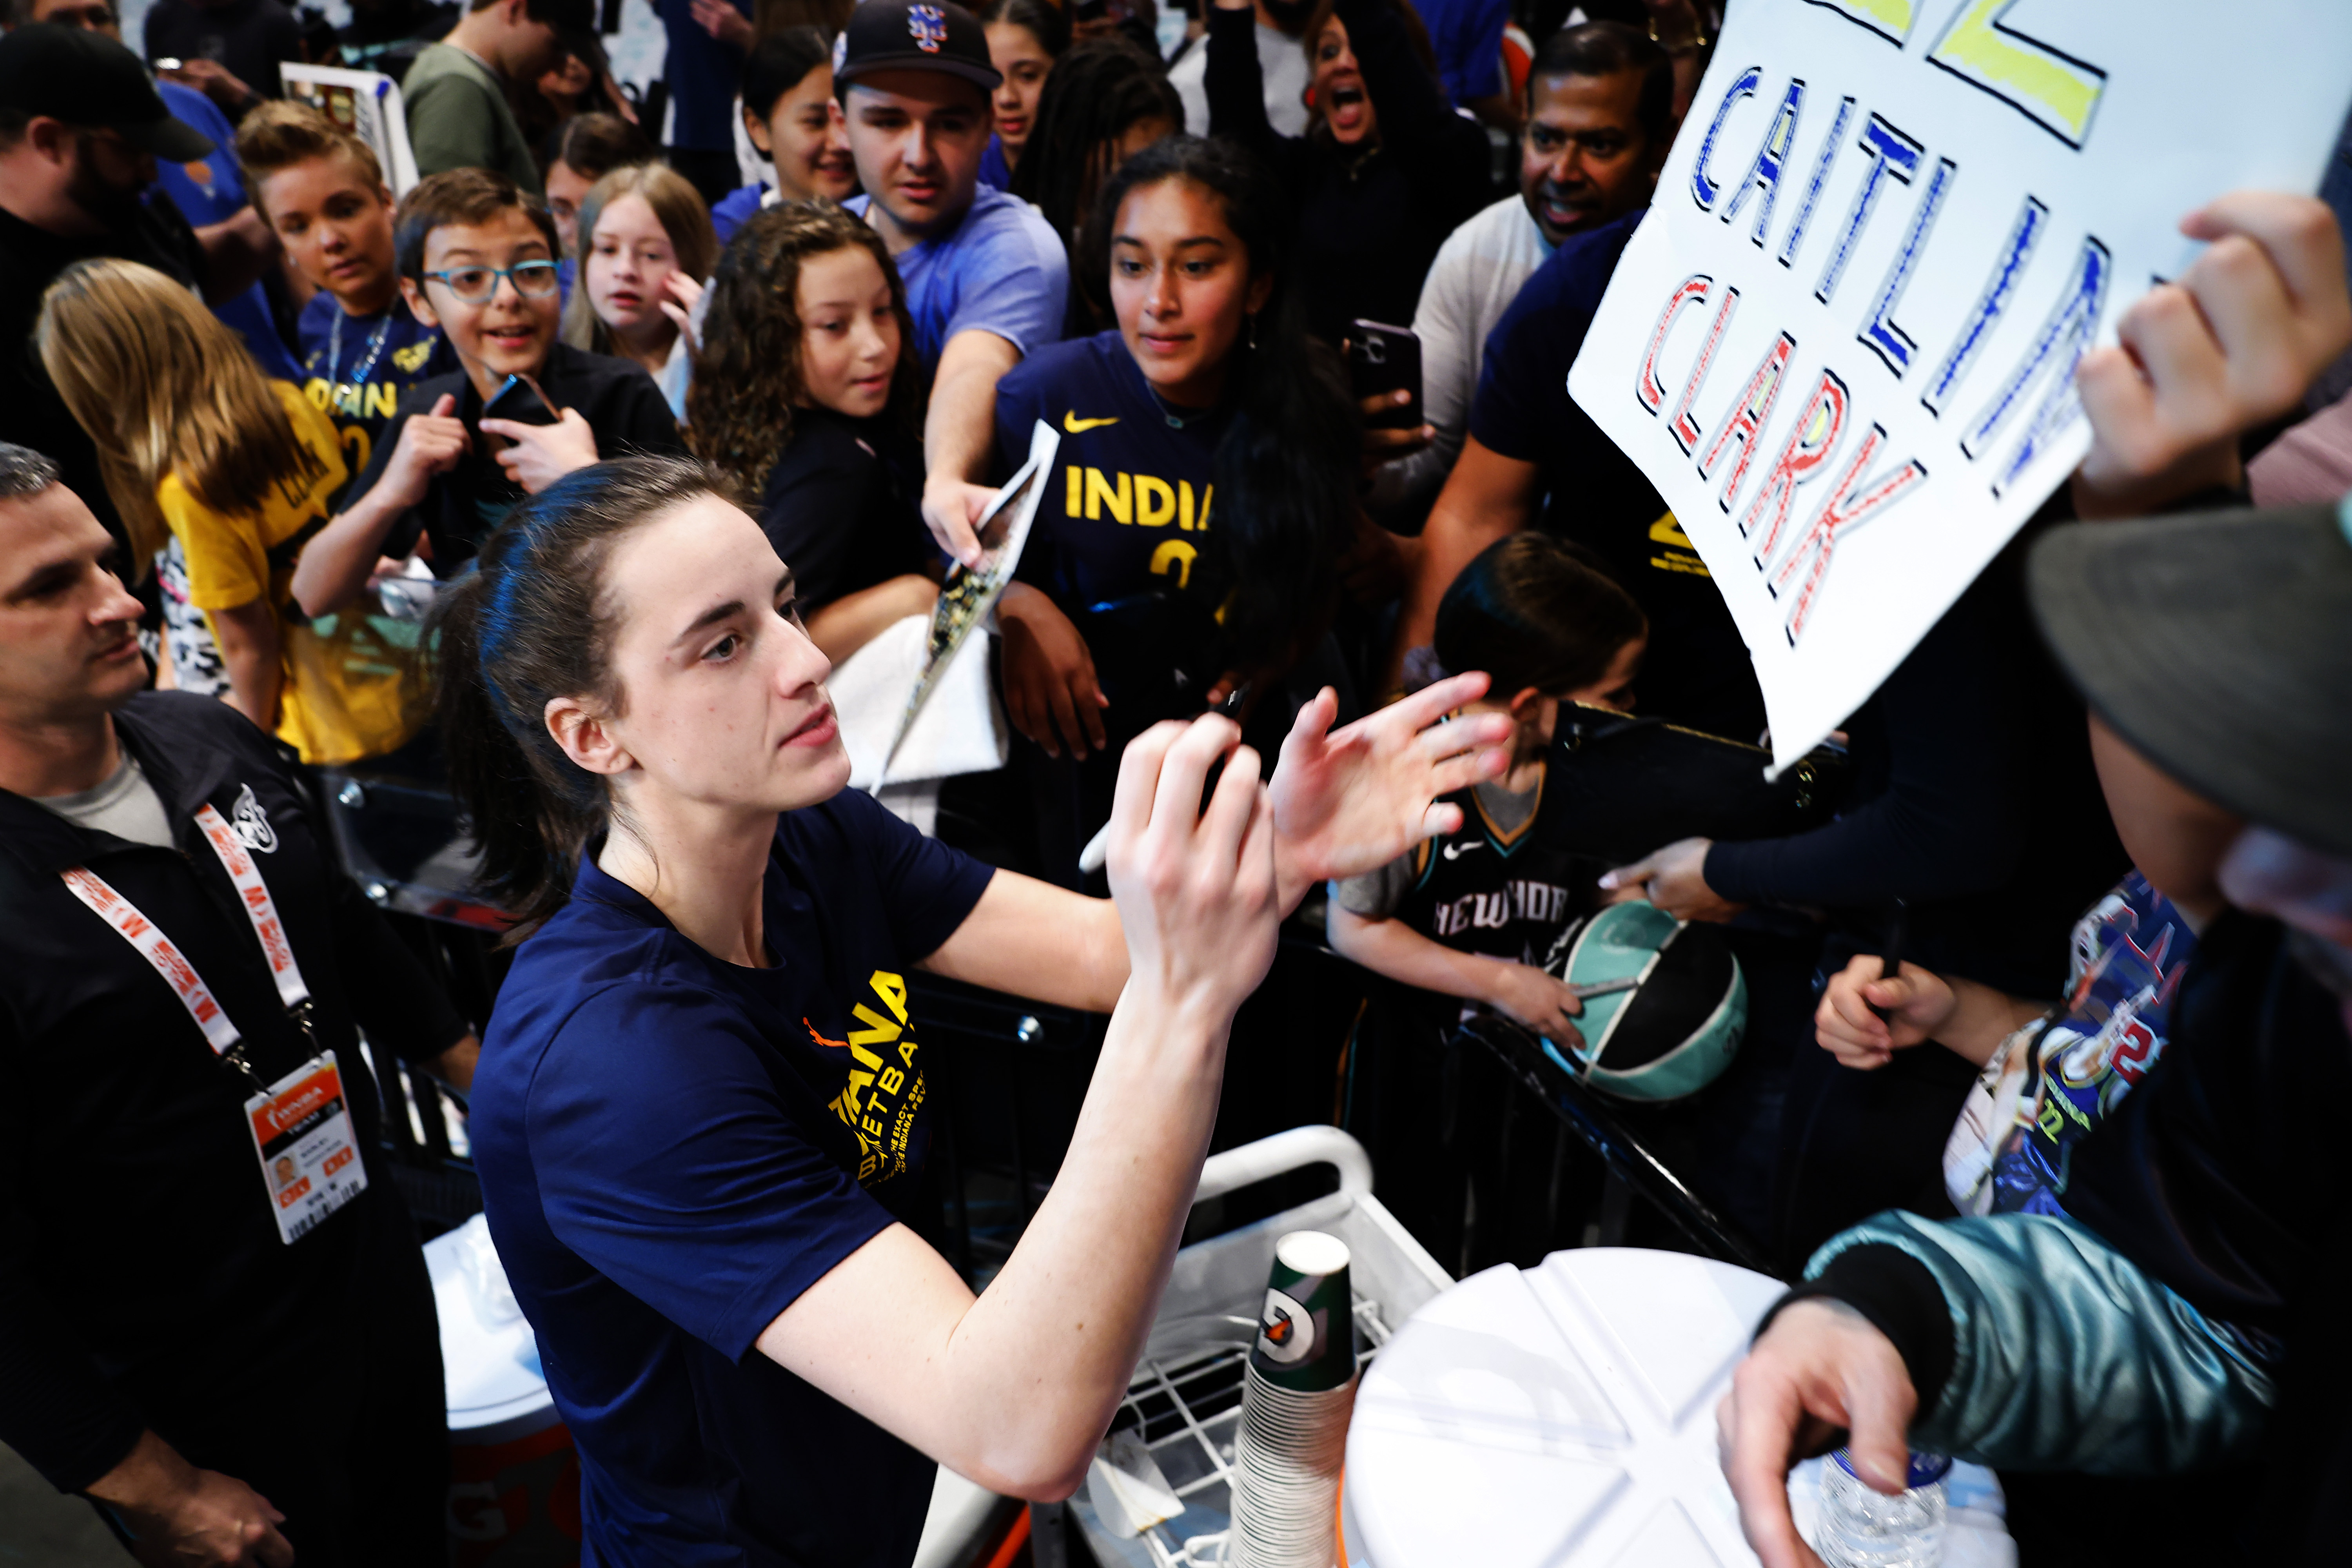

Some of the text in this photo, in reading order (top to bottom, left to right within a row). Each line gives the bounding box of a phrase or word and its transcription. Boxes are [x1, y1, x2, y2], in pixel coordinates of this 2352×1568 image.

[1637, 274, 1929, 648] CLARK
[1506, 879, 1569, 923] YOR
[892, 1102, 909, 1138] EXACT
[898, 1113, 915, 1152] INDIANA
